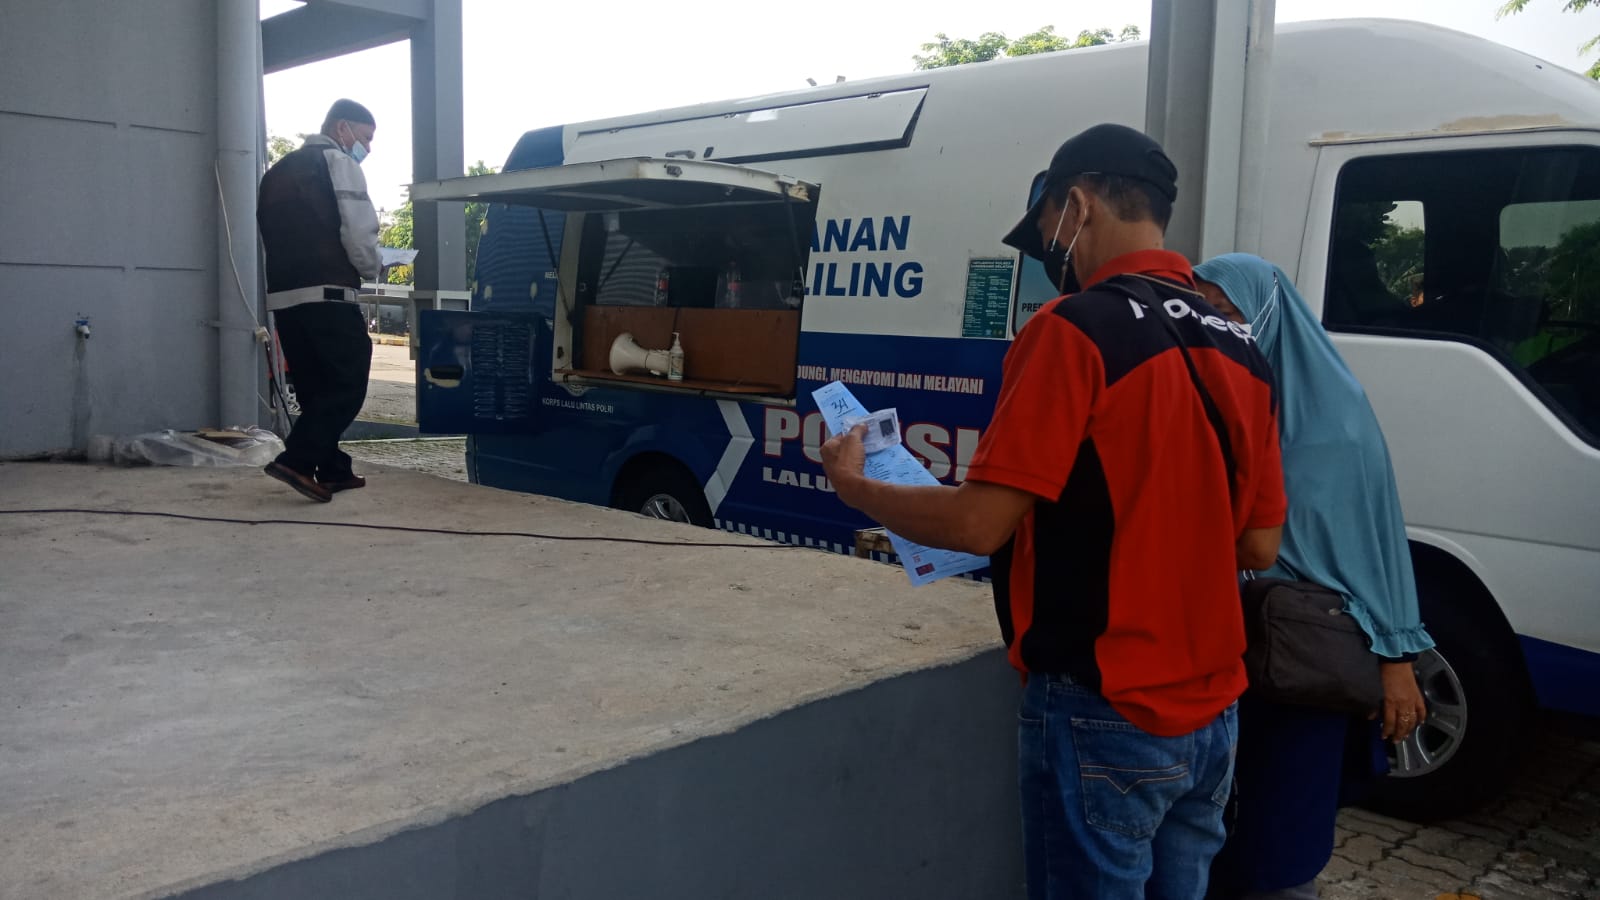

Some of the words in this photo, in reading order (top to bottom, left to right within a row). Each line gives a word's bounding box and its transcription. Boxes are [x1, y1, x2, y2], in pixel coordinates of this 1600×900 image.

[804, 261, 924, 298] ILING
[830, 368, 895, 387] MENGAYOMI
[897, 373, 922, 389] DAN
[923, 376, 985, 395] MELAYANI
[561, 399, 575, 409] LALU
[576, 400, 596, 411] LINTAS
[763, 405, 979, 484] POSI
